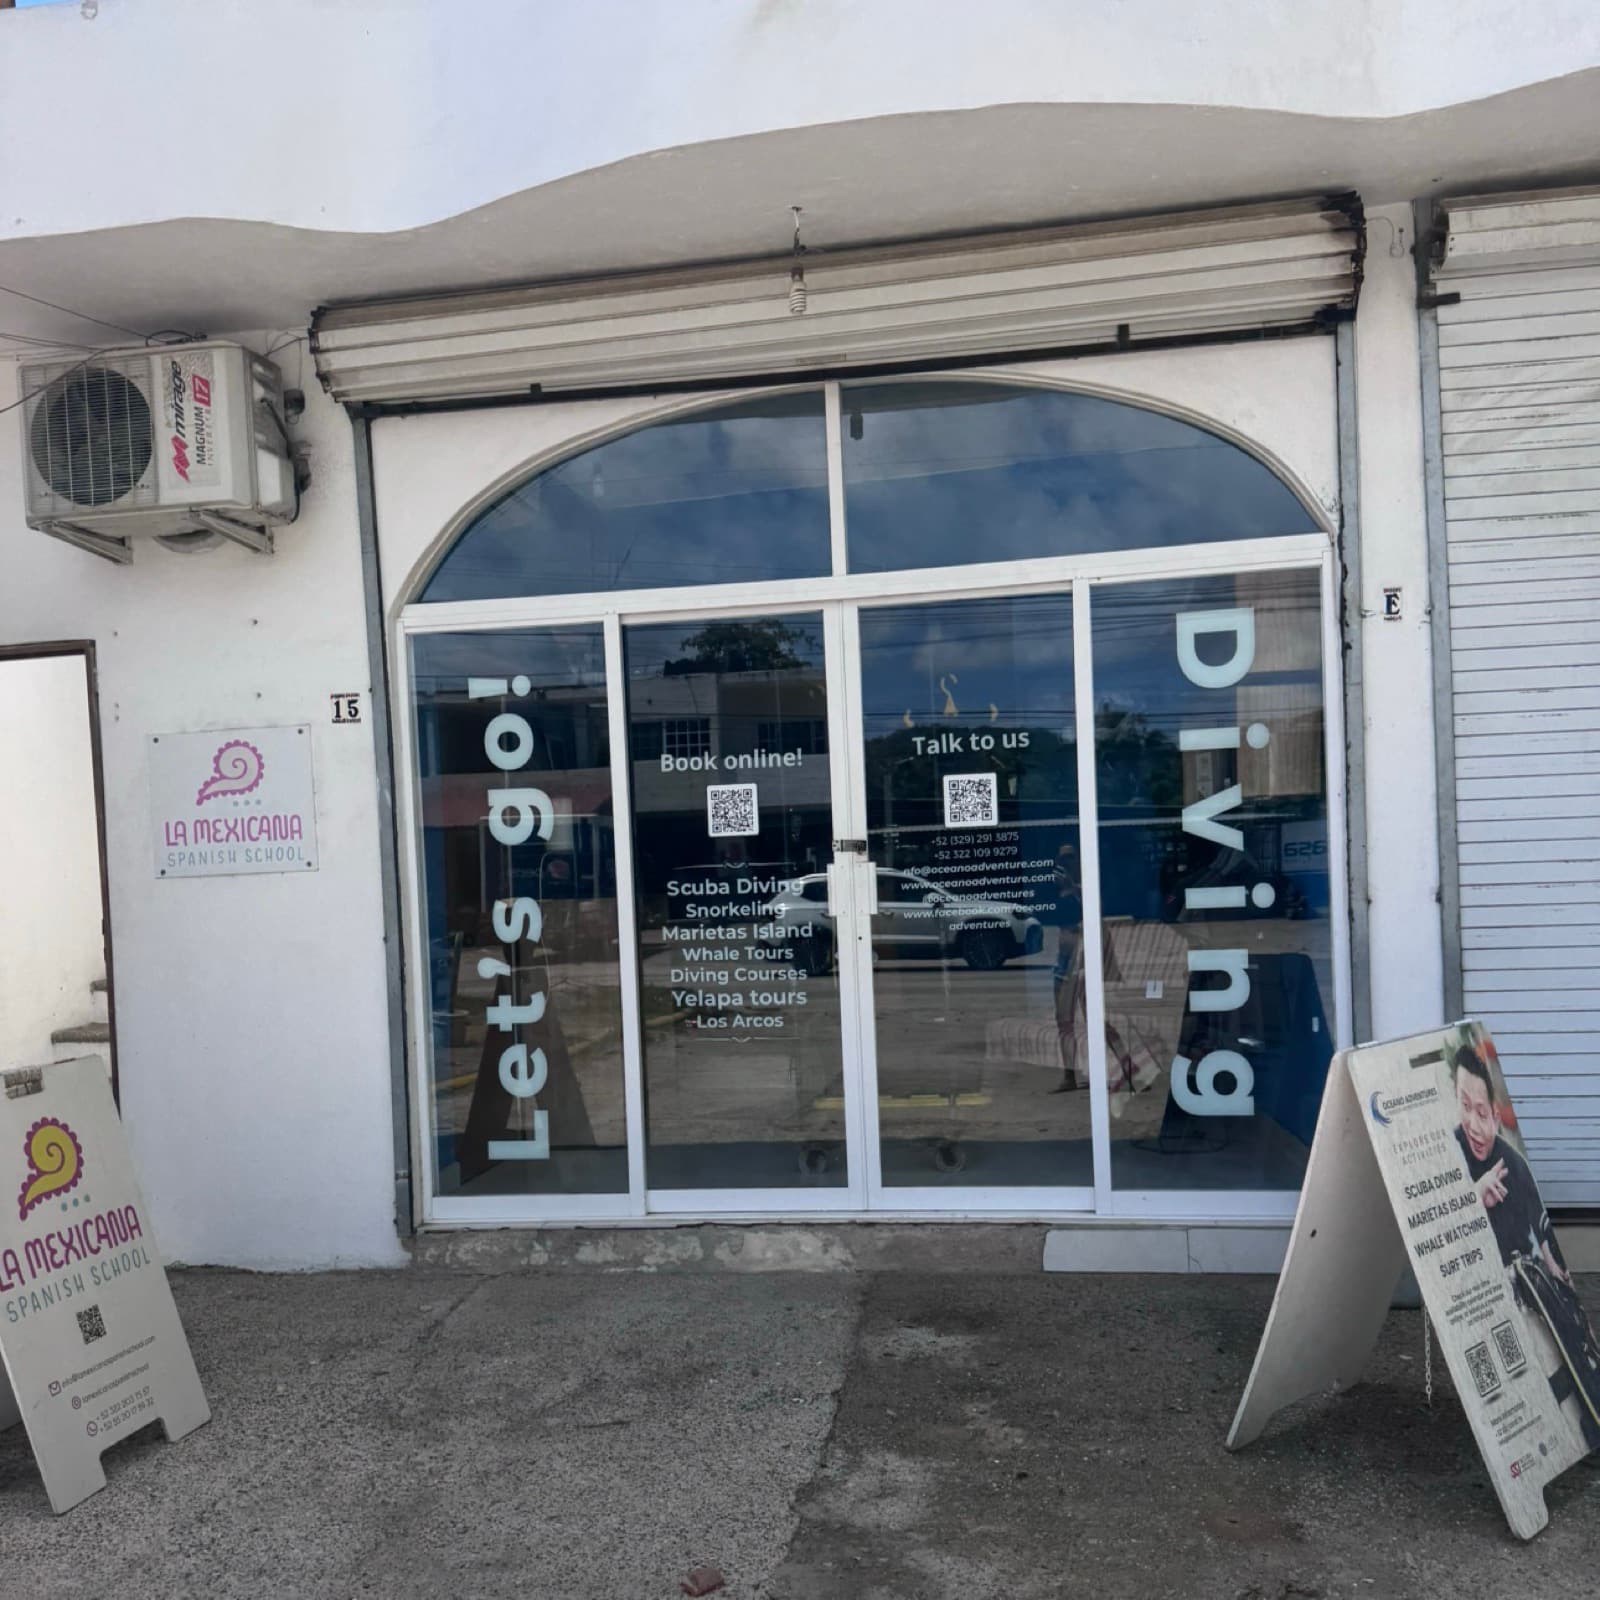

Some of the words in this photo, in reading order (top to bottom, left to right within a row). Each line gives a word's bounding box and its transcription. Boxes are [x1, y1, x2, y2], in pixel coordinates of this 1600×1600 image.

[171, 361, 186, 439] mirage
[194, 406, 206, 465] MAGNUM
[1384, 593, 1400, 615] E
[333, 698, 359, 719] 15
[912, 732, 964, 756] Talk
[969, 733, 995, 751] to
[1002, 732, 1030, 749] us
[468, 675, 554, 845] go!
[660, 751, 718, 772] Book
[724, 747, 803, 770] online!
[165, 820, 187, 847] LA
[193, 814, 303, 845] MEXICANA
[167, 849, 237, 868] SPANISH
[245, 846, 304, 865] SCHOOL
[952, 849, 971, 859] 322
[993, 846, 1018, 857] 9279
[1170, 607, 1275, 1116] Diving
[667, 878, 730, 896] Scuba
[737, 876, 804, 895] Diving
[686, 901, 786, 919] Snorkeling
[662, 924, 747, 941] Marietas
[753, 921, 813, 938] Island
[683, 947, 740, 961] Whale
[744, 946, 794, 960] Tours
[671, 967, 729, 985] Diving
[734, 967, 808, 982] Courses
[671, 989, 744, 1010] Yelapa
[750, 990, 808, 1006] tours
[477, 896, 550, 1160] Let's
[696, 1015, 727, 1029] Los
[732, 1014, 784, 1028] Arcos
[1404, 1178, 1435, 1200] SCUBA
[1434, 1168, 1463, 1189] DIVING
[1407, 1203, 1449, 1230] MARIETAS
[1449, 1191, 1477, 1213] ISLAND
[24, 1205, 143, 1279] MEXICANA
[1414, 1234, 1445, 1258] WHALE
[1443, 1216, 1488, 1245] WATCHING
[1439, 1258, 1460, 1278] SURF
[1460, 1248, 1483, 1269] TRIPS
[6, 1273, 86, 1323] SPANISH
[90, 1246, 151, 1286] SCHOOL
